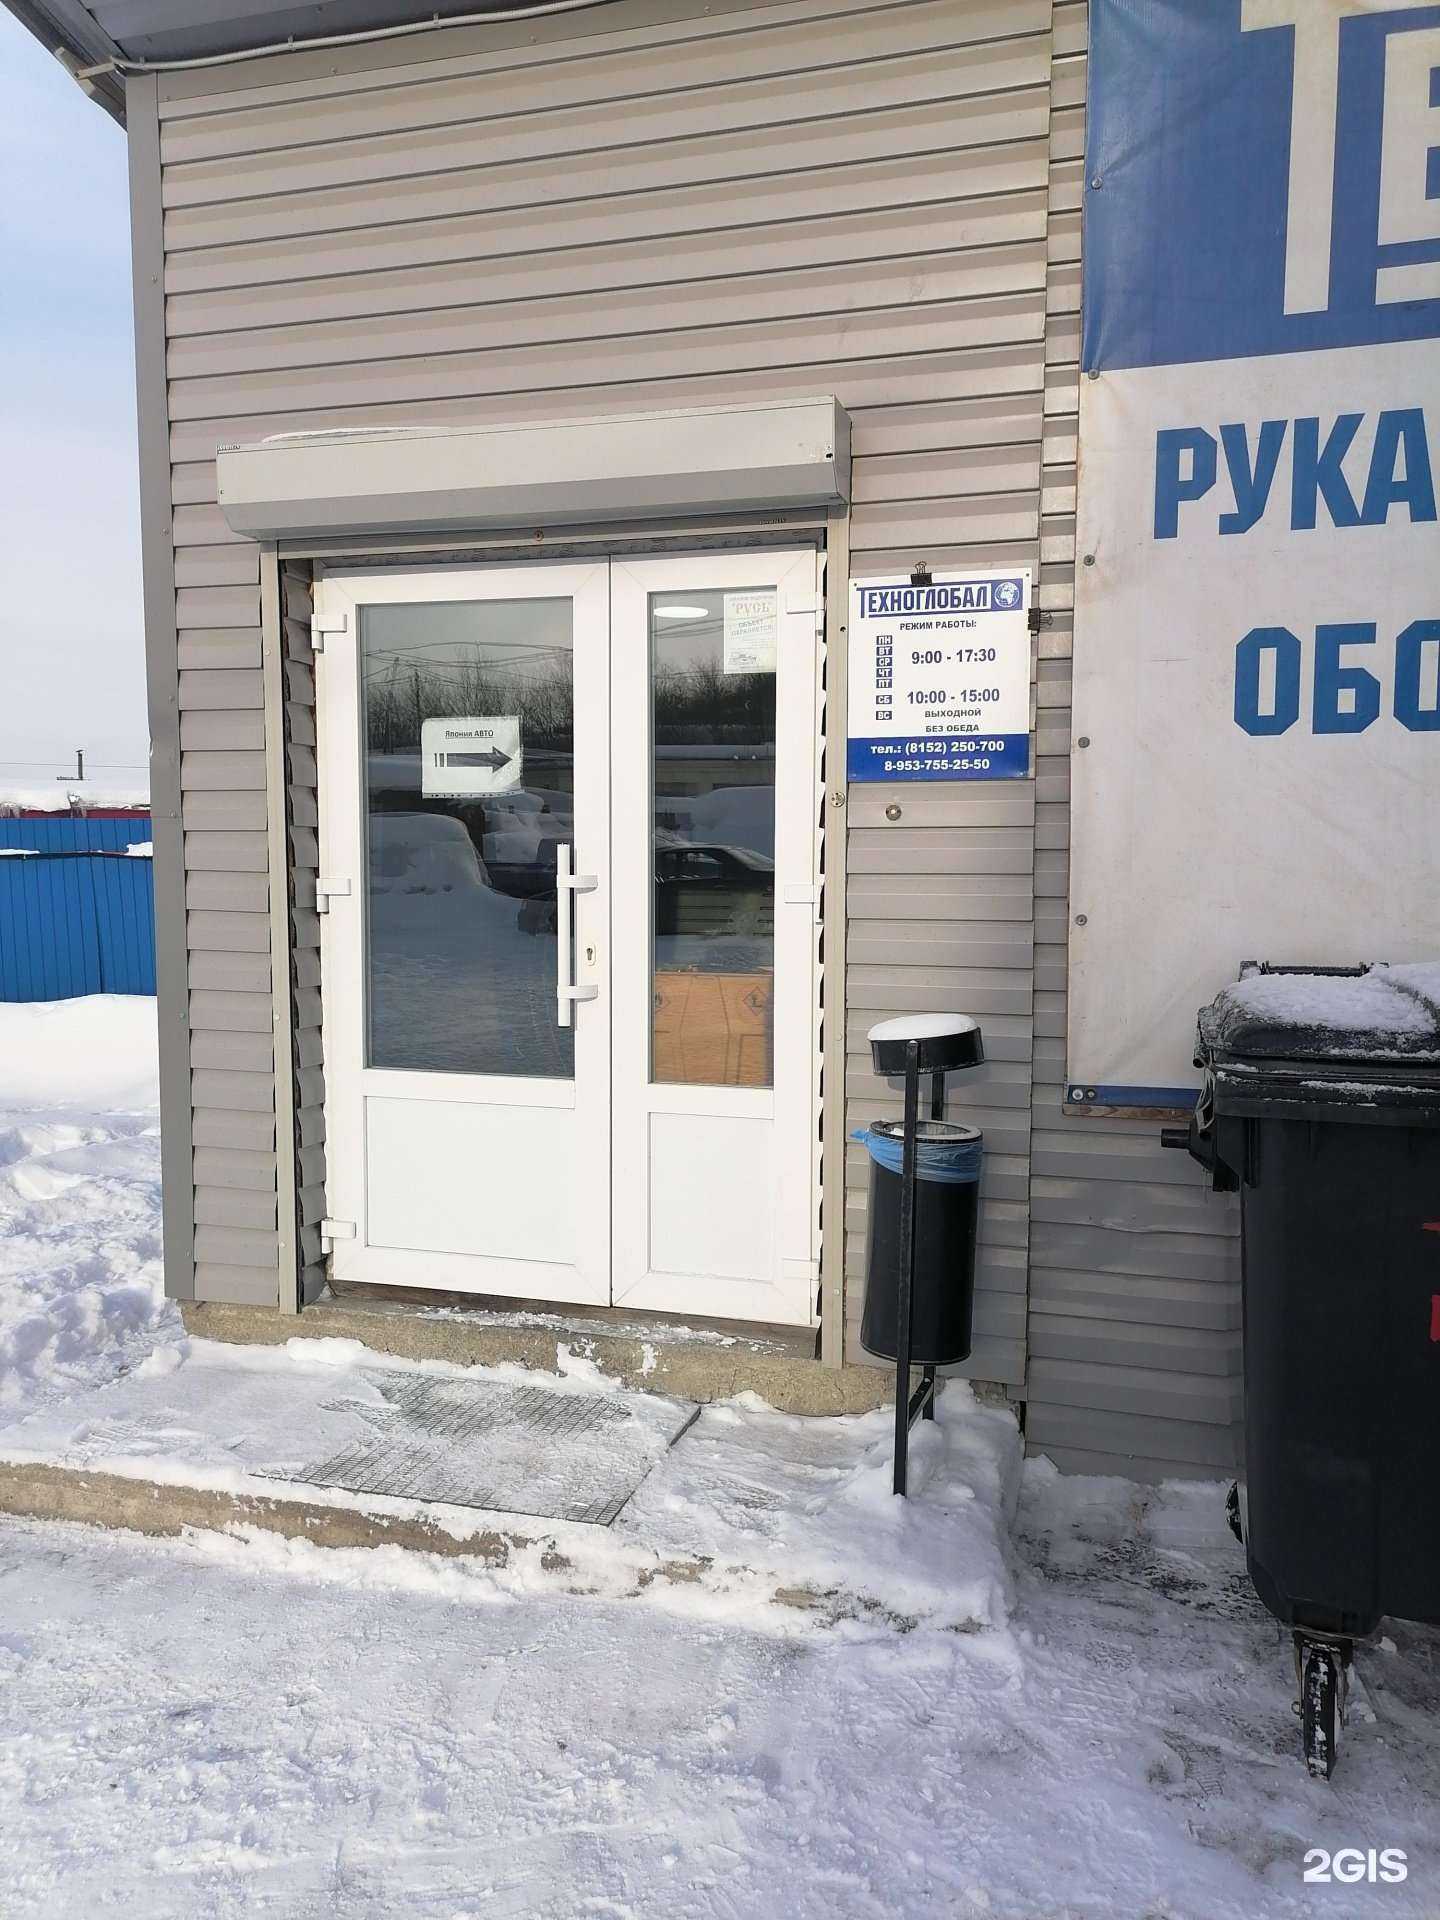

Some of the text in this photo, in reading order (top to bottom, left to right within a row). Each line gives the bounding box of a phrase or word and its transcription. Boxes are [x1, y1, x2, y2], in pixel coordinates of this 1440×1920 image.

[1154, 408, 1438, 540] РУКА
[856, 584, 988, 619] ТЕХНОГЛОБАЛ
[900, 619, 977, 630] РЕЖИМ РАБОТЫ:
[878, 636, 892, 645] ПН
[878, 647, 892, 656] ВТ
[911, 650, 942, 664] 9:00
[956, 648, 996, 663] 17:30
[878, 657, 892, 667] СР
[878, 668, 892, 677] ЧТ
[1234, 619, 1440, 737] ОБО
[878, 679, 892, 688] ПТ
[878, 695, 891, 704] СБ
[907, 690, 946, 704] 10:00
[960, 688, 1000, 703] 15:00
[877, 711, 891, 720] ВС
[924, 708, 982, 718] ВЫХОДНОЙ
[925, 724, 980, 733] БЕЗ ОБЕДА
[870, 740, 1005, 755] тел.: (8152) 250-700
[884, 759, 990, 772] 8-953-755-25-50
